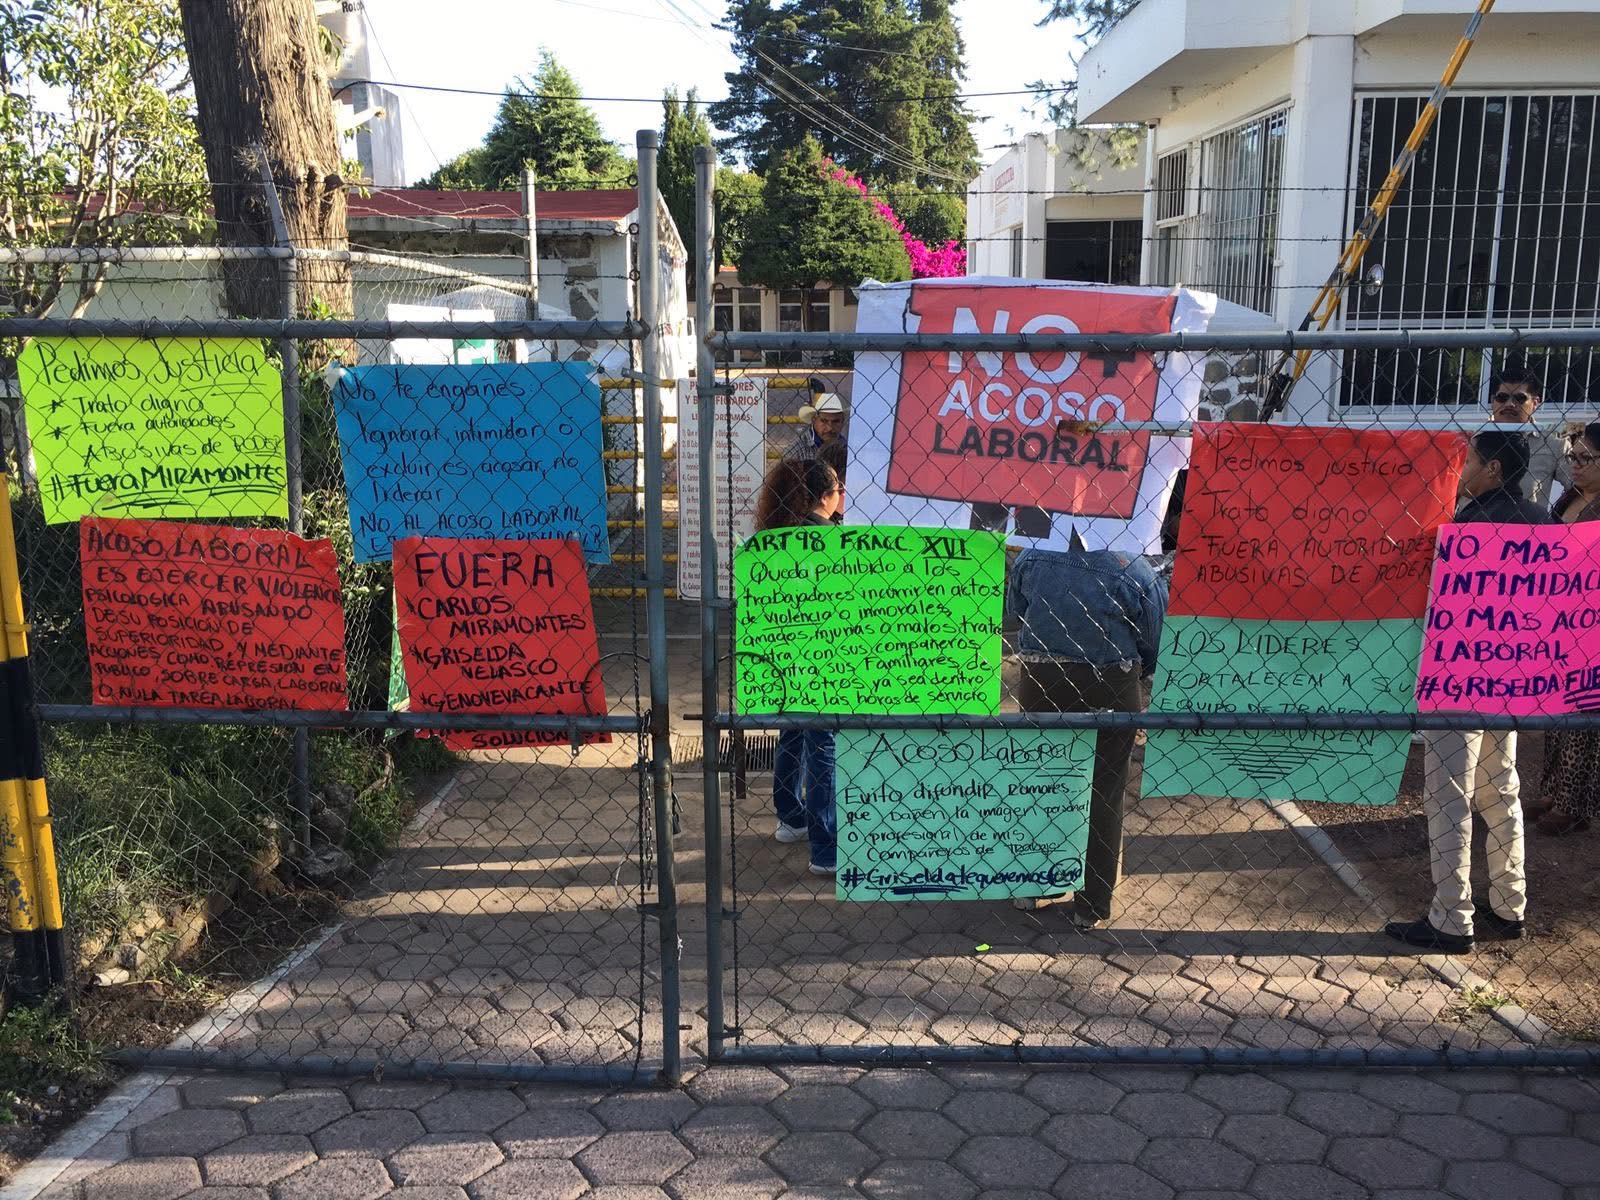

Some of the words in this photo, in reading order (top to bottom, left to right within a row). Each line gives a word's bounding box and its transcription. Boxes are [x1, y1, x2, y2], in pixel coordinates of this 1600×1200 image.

[35, 342, 140, 385] Pedimos
[339, 373, 375, 401] No
[393, 368, 418, 399] te
[80, 395, 128, 415] Trato
[141, 394, 204, 418] digno
[938, 379, 1126, 427] ACOSO
[202, 438, 223, 455] de
[933, 422, 1129, 473] LABORAL
[1210, 430, 1304, 473] Pedimos
[367, 452, 434, 478] excluir
[444, 461, 468, 475] es
[554, 457, 578, 470] no
[360, 514, 390, 536] NO
[404, 516, 420, 530] AL
[439, 515, 492, 531] ACOSO
[502, 506, 583, 527] LABORAL
[1201, 488, 1269, 521] Trato
[1292, 498, 1367, 533] digno
[88, 527, 163, 556] ACOSO
[174, 537, 314, 568] LABORAL
[745, 530, 793, 552] ART
[796, 530, 826, 552] 98
[1201, 535, 1278, 559] FUERA
[1500, 540, 1568, 565] MAS
[97, 567, 127, 582] ES
[137, 568, 248, 595] EJERCER
[414, 551, 554, 588] FUERA
[750, 561, 808, 584] Queda
[816, 557, 896, 581] prohibido
[903, 563, 914, 574] a
[925, 558, 960, 576] los
[1197, 564, 1308, 587] ABUSIVAS
[1331, 564, 1362, 584] DE
[418, 595, 513, 620] CARLOS
[744, 586, 854, 609] trabajadores
[927, 585, 945, 595] en
[202, 599, 312, 620] ABUSANDO
[1465, 606, 1542, 631] MAS
[228, 620, 253, 635] DE
[449, 614, 586, 638] MIRAMONTES
[897, 617, 956, 634] malos
[255, 641, 343, 661] MEDIANTE
[740, 648, 792, 665] contra
[804, 649, 833, 660] con
[841, 645, 867, 655] sus
[1171, 630, 1225, 657] LOS
[1237, 629, 1360, 657] LIDERES
[1433, 640, 1568, 663] LABORAL
[423, 642, 526, 669] GRISELDA
[762, 663, 819, 679] contra
[827, 662, 855, 674] sus
[966, 650, 991, 670] de
[161, 669, 218, 684] SOBRE
[314, 663, 340, 675] EN
[1163, 669, 1323, 692] FORTALECEN
[1371, 676, 1411, 693] SU
[810, 677, 864, 689] otros
[872, 679, 891, 692] ya
[897, 675, 925, 686] sea
[930, 671, 983, 686] dentro
[823, 692, 849, 705] las
[857, 691, 901, 704] horas
[904, 691, 920, 703] de
[1160, 698, 1237, 713] EQUIPO
[864, 732, 974, 769] Acoso
[846, 811, 871, 826] que
[956, 806, 969, 819] la
[970, 831, 987, 841] de
[993, 830, 1024, 841] mis
[976, 844, 994, 855] de
